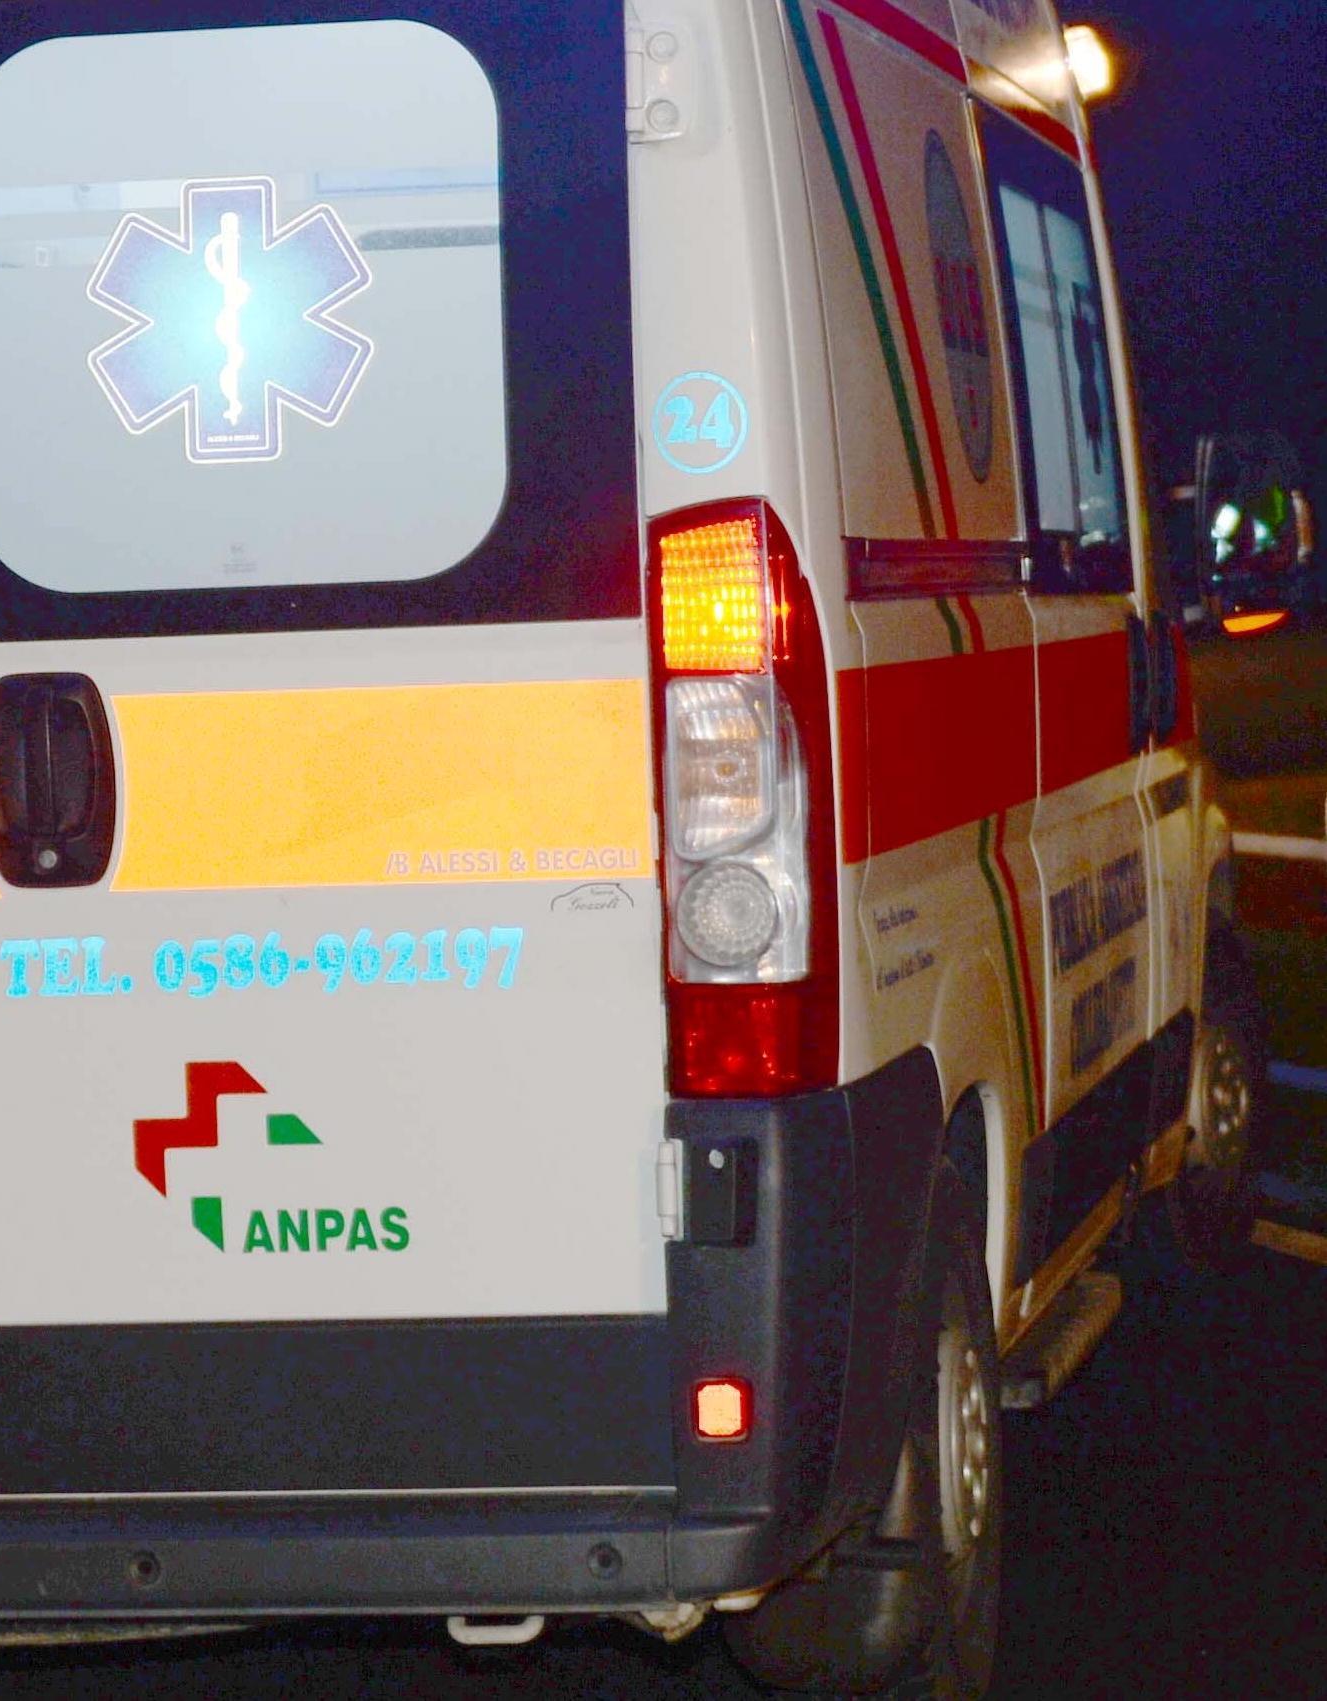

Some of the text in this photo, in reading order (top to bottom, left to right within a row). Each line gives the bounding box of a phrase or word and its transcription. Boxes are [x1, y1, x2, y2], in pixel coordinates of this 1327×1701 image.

[665, 391, 734, 450] 24
[419, 851, 499, 874] ALESSI
[508, 850, 527, 873] &
[536, 847, 639, 871] BECAGLI
[0, 926, 523, 999] TEL. 0586-962197
[242, 1206, 410, 1253] ANPAS
